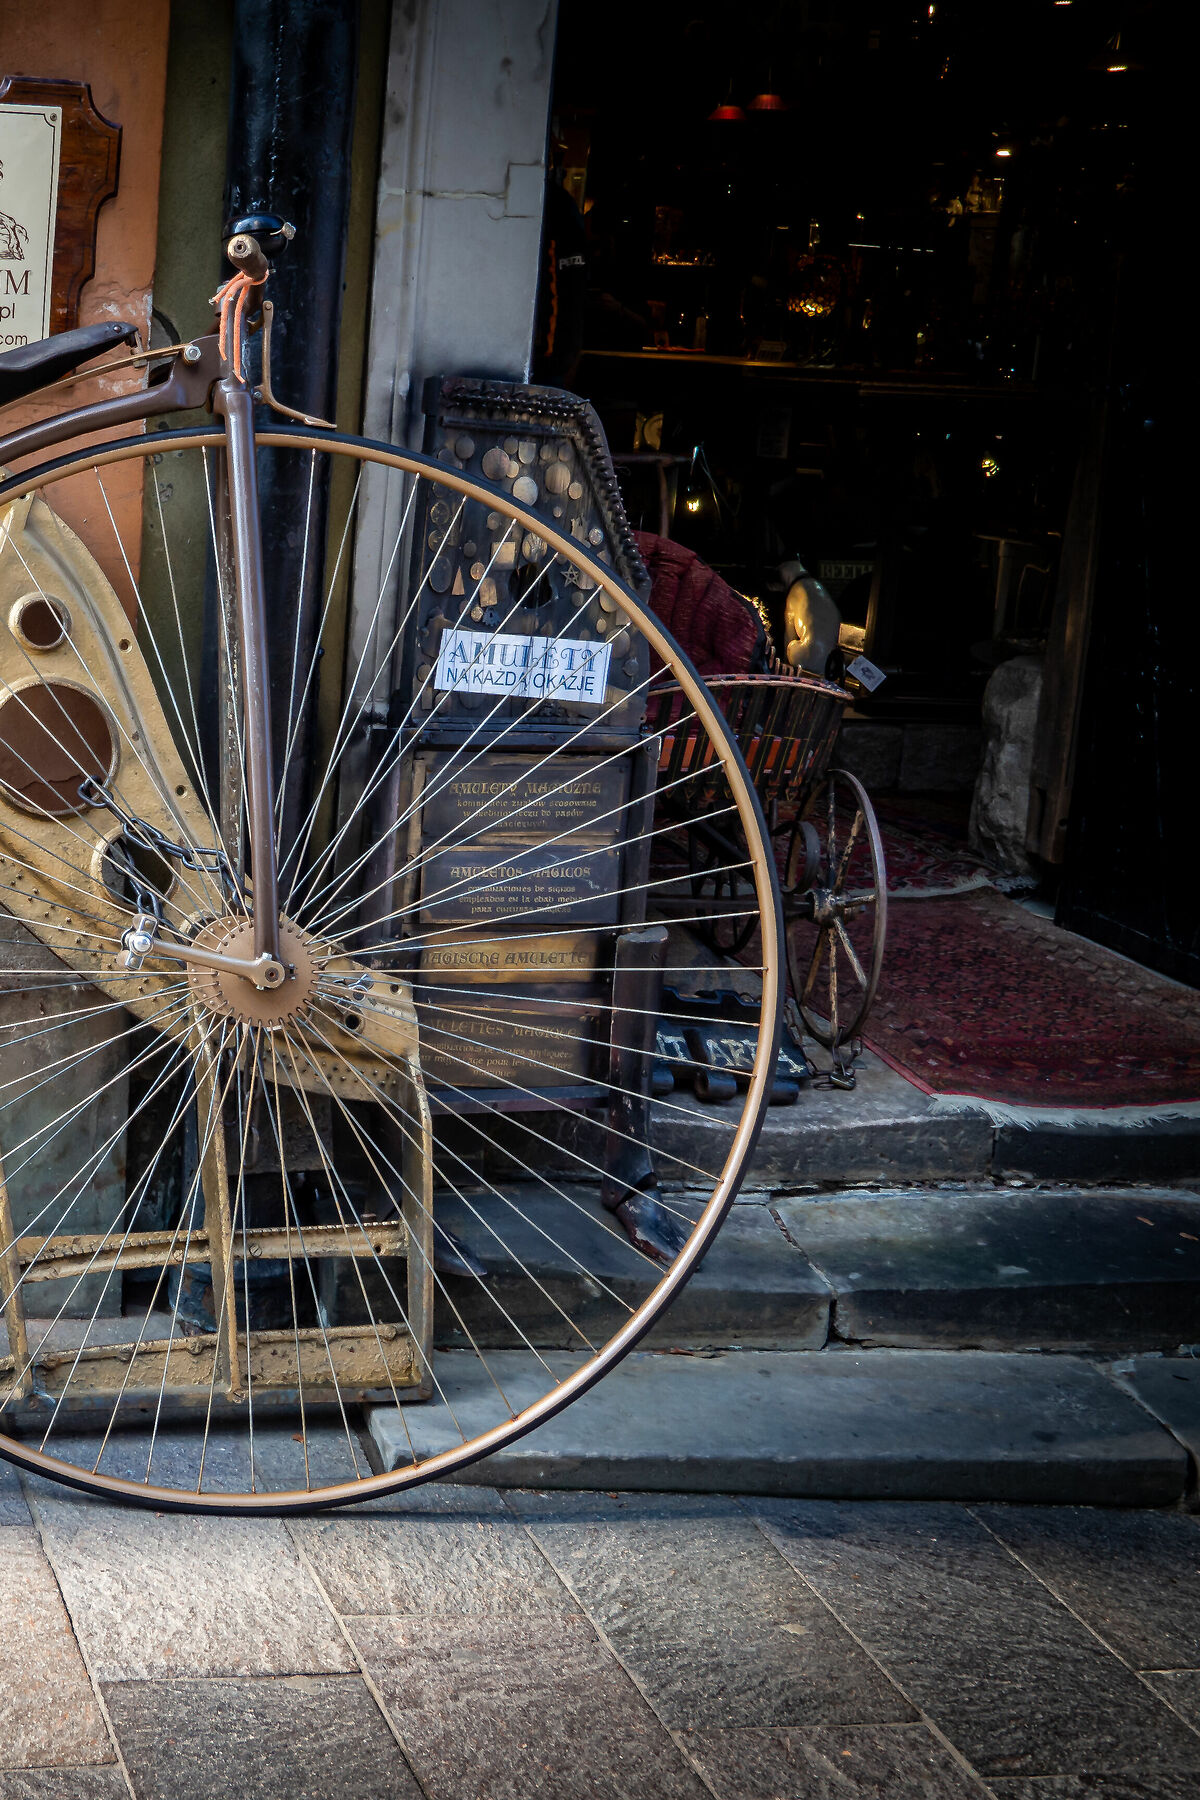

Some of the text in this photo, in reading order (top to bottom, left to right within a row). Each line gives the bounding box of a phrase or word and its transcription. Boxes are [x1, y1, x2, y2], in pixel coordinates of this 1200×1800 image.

[448, 640, 603, 671] AMULETY
[446, 667, 596, 696] NA KAŻDĄ OKAZJĘ
[450, 866, 524, 879] AMULETOS
[421, 1018, 581, 1040] MULETTES MAGIQUE
